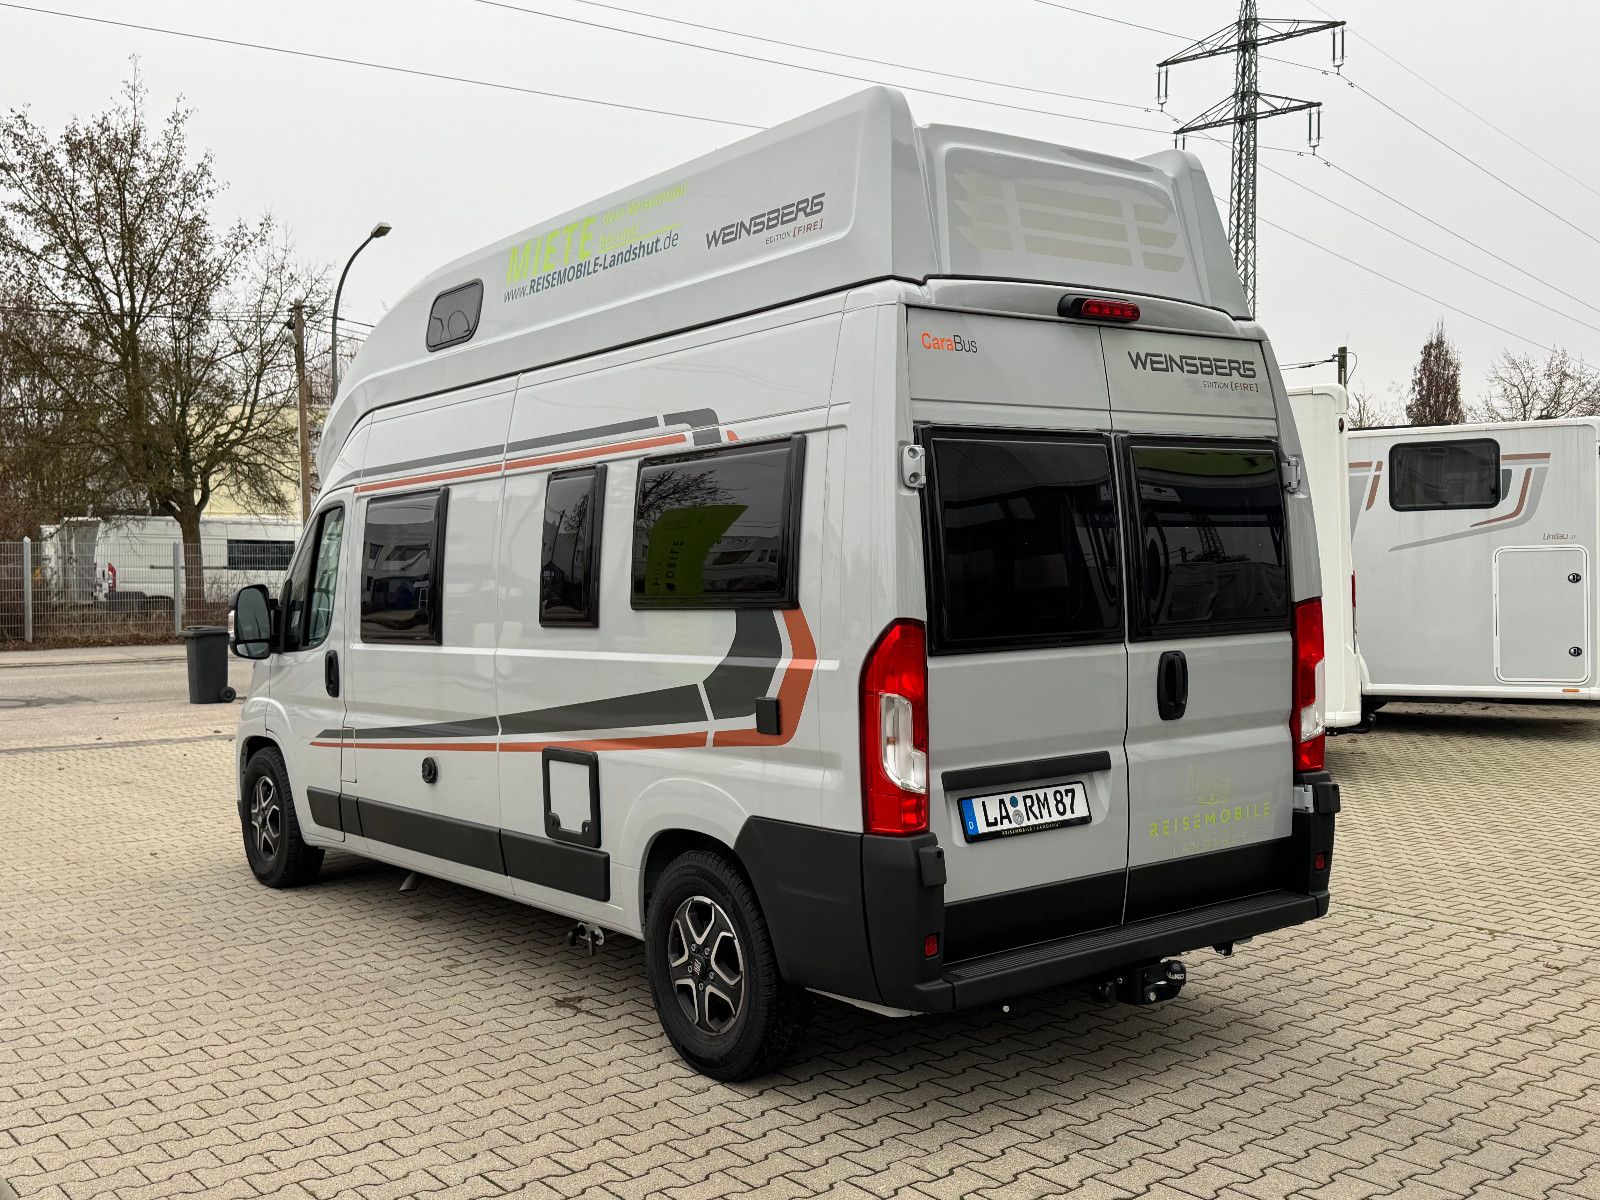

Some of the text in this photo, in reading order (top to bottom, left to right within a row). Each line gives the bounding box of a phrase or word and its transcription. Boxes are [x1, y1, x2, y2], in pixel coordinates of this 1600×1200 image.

[705, 192, 825, 249] WEINSBERG
[506, 215, 597, 288] MIETE
[766, 230, 791, 245] EDITION
[504, 229, 679, 303] www.REISEMOBILE-Landshut.de
[921, 332, 978, 353] CaraBus
[1127, 350, 1257, 379] WEINSBERG
[1203, 380, 1229, 389] EDITION
[1542, 532, 1569, 541] Lindau
[981, 798, 1012, 828] LA
[1023, 791, 1053, 822] RM
[1055, 788, 1076, 816] 87
[1149, 801, 1272, 838] REISEMOBILE
